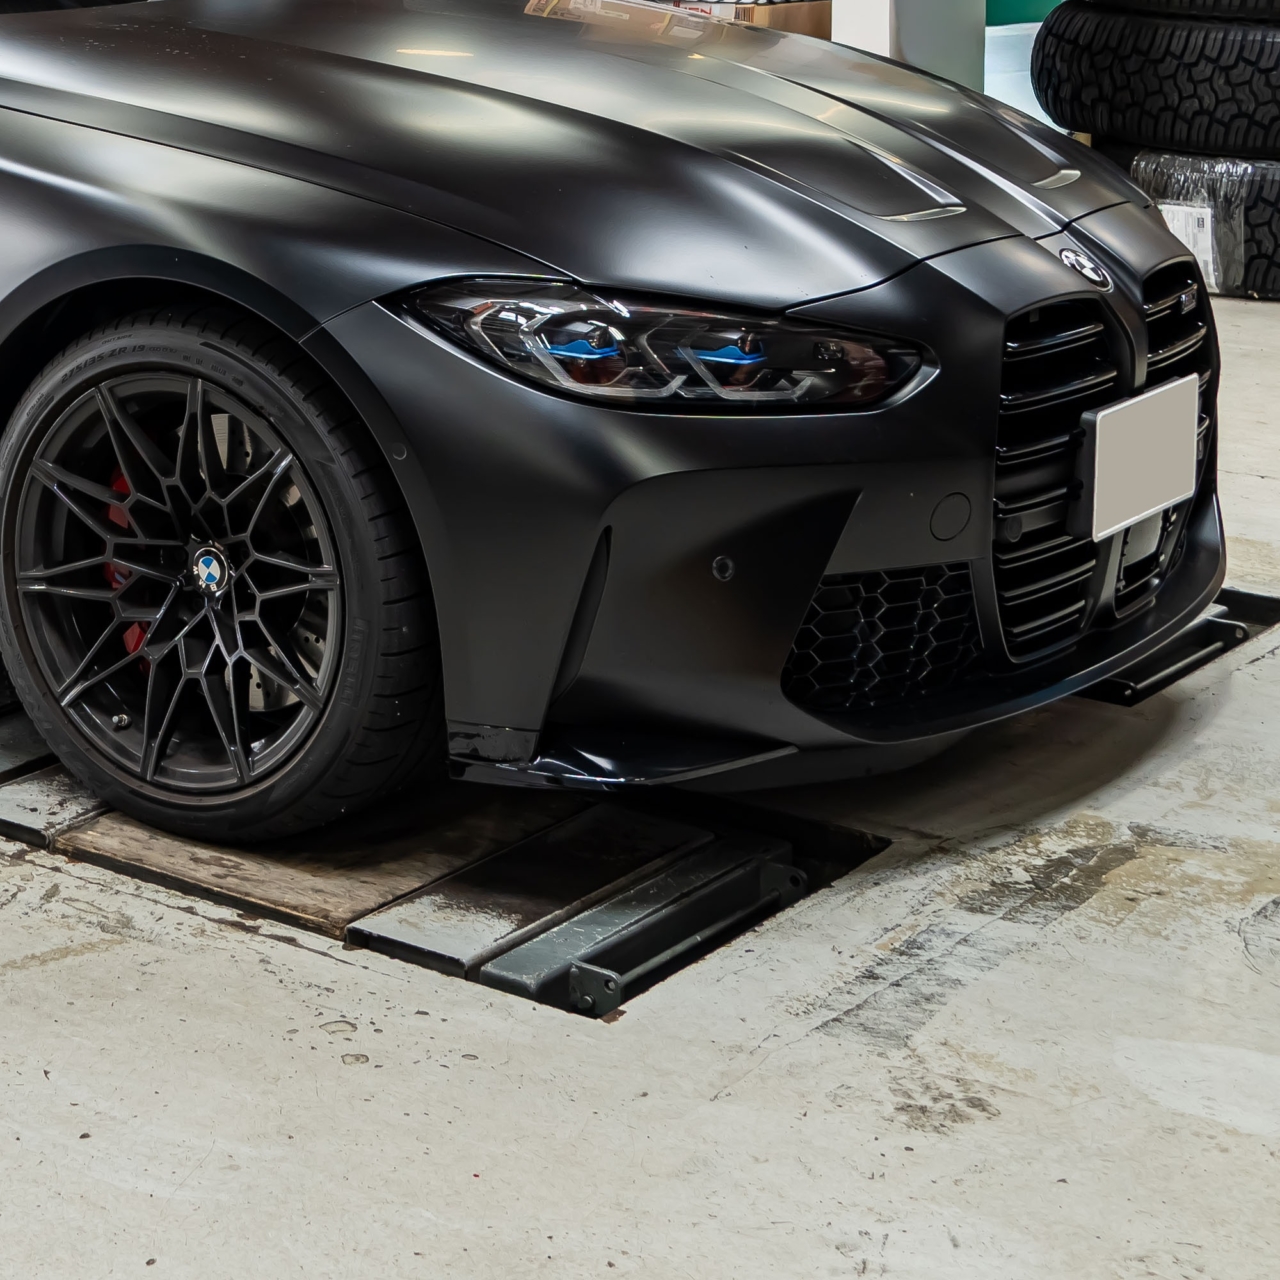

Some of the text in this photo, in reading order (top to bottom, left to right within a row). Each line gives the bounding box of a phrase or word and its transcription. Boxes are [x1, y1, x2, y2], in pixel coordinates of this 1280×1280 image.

[61, 351, 105, 384] 275/35
[109, 346, 129, 358] ZR
[131, 344, 146, 352] 19
